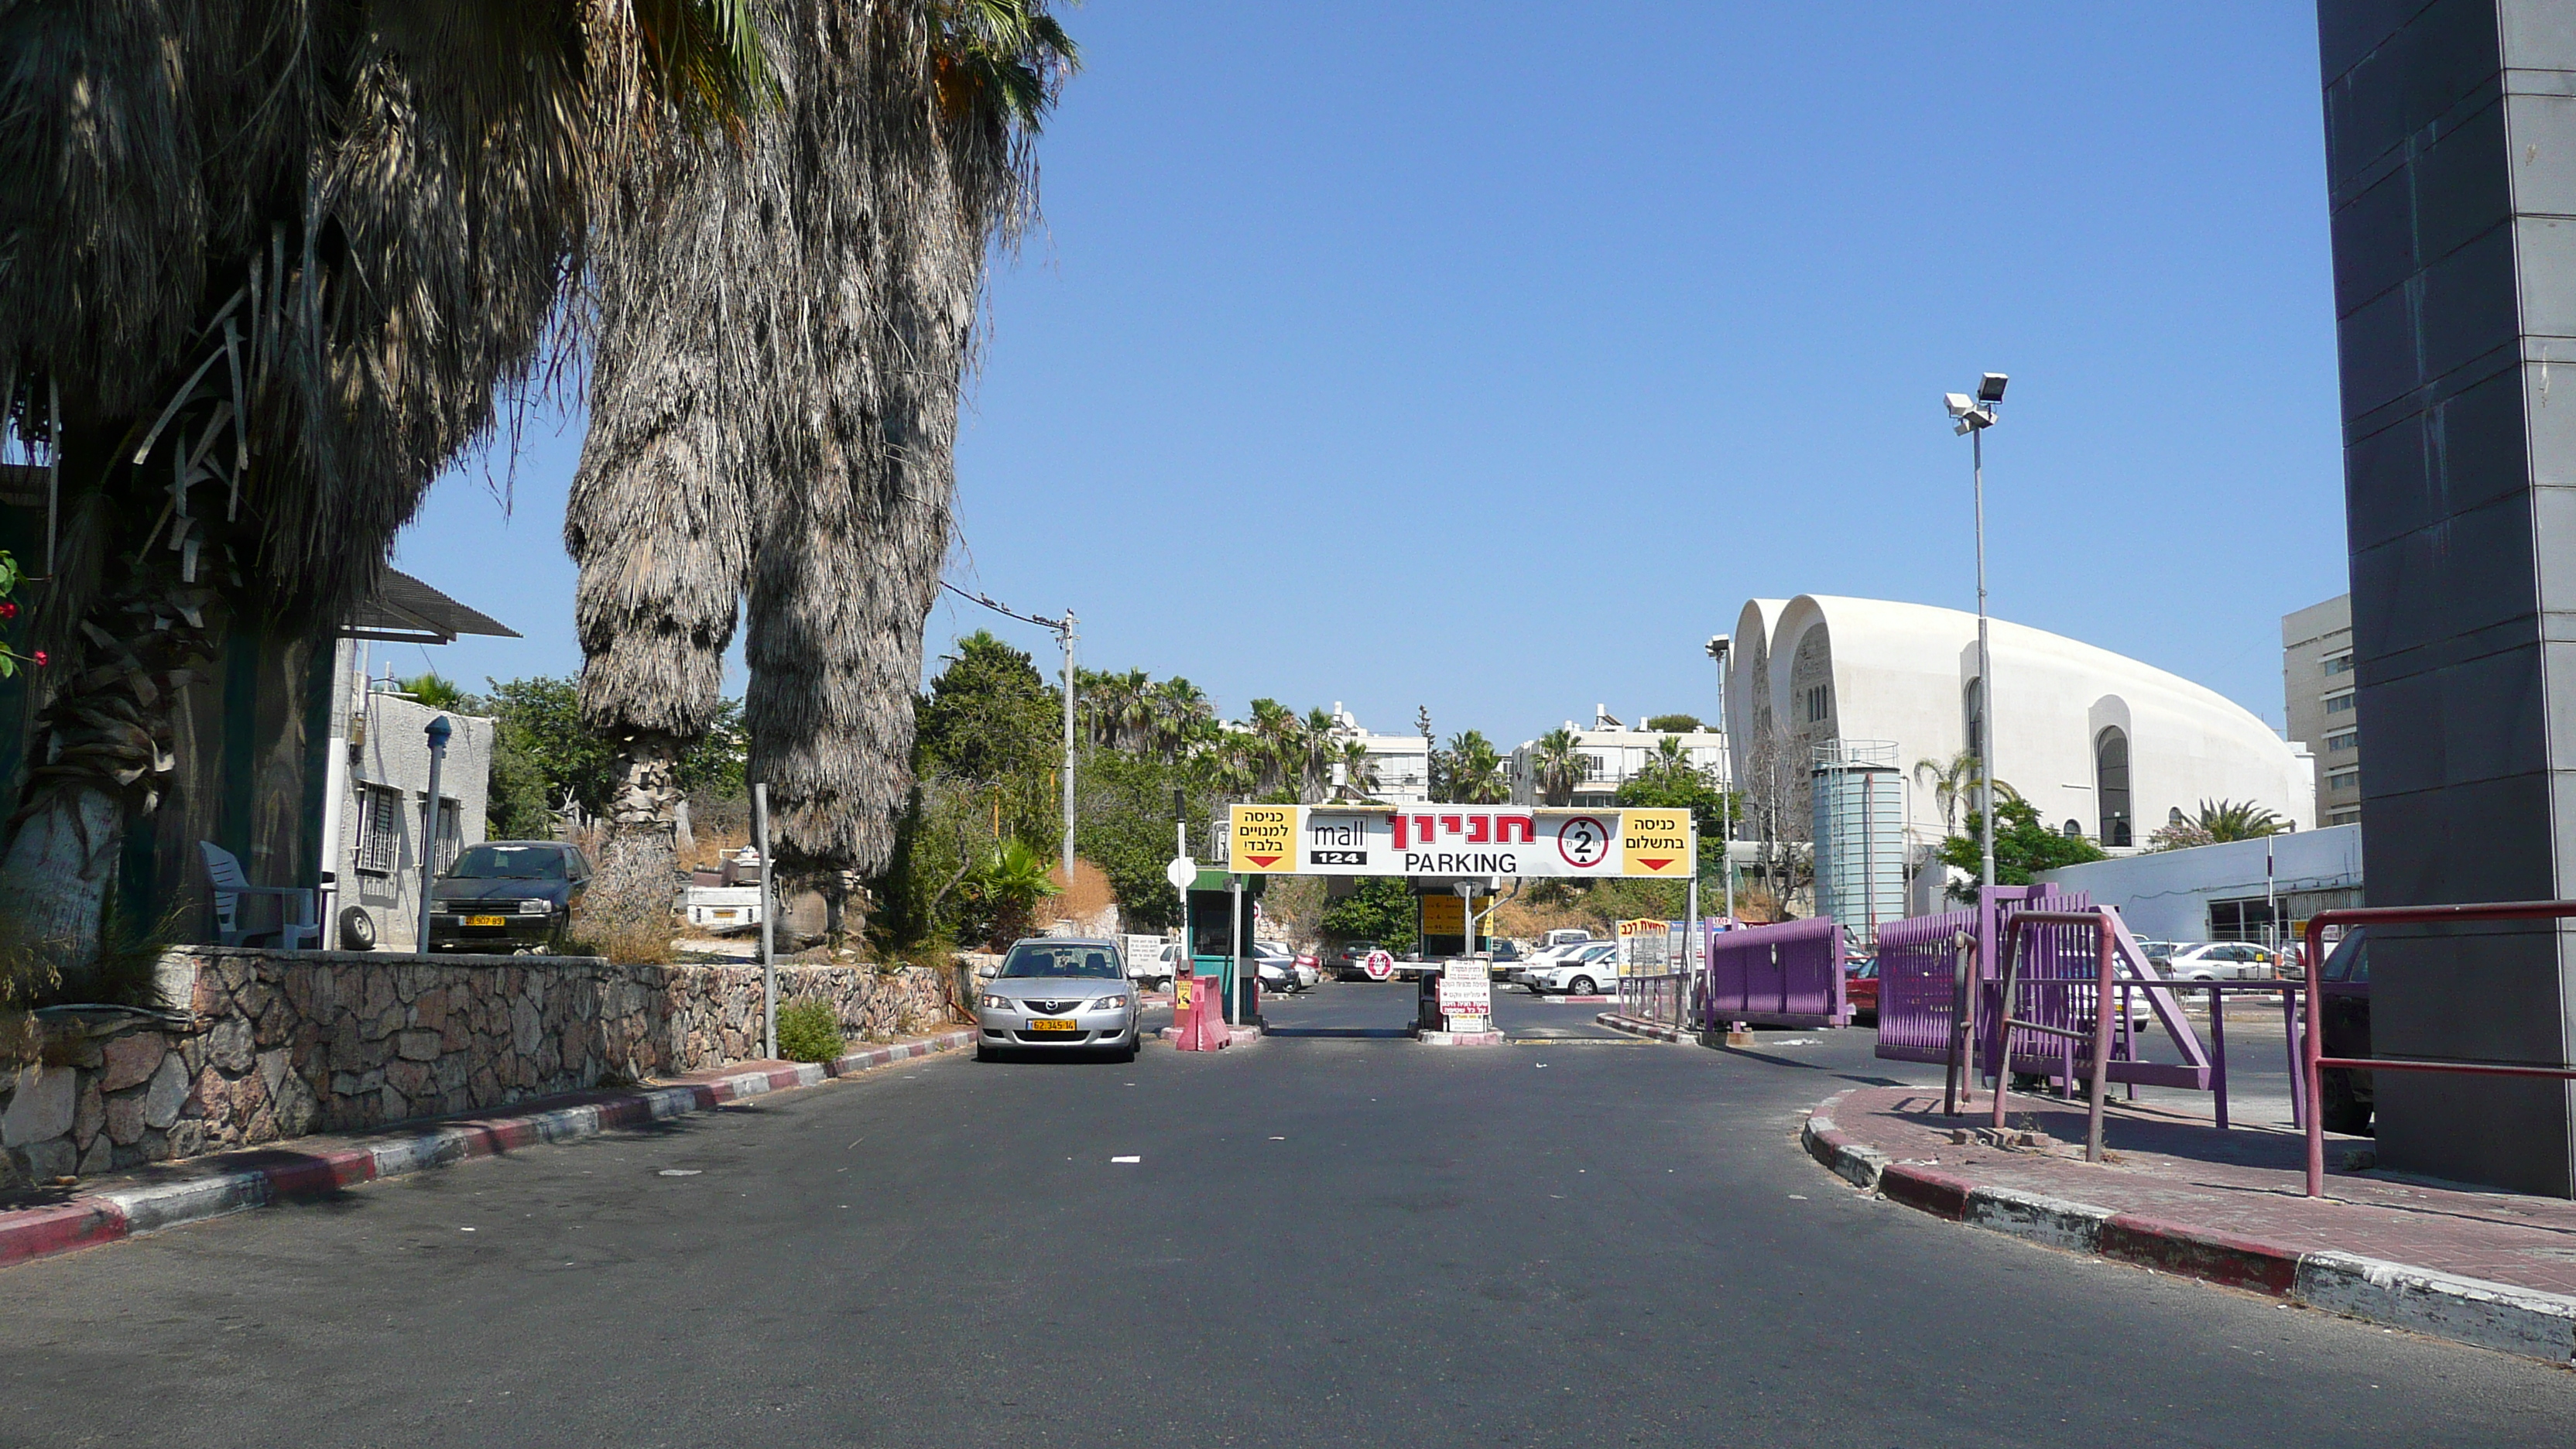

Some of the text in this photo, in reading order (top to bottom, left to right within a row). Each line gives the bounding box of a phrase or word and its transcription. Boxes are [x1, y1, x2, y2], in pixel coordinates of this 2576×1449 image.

[1244, 812, 1284, 822] כניסה
[1239, 824, 1289, 837] למנויים
[1634, 819, 1676, 831] כניסה
[1314, 820, 1364, 846] mall
[1385, 813, 1536, 851] חניון
[1625, 835, 1685, 849] בתשלום
[1318, 852, 1359, 864] 124
[1405, 853, 1517, 873] PARKING
[1621, 922, 1638, 935] רכב
